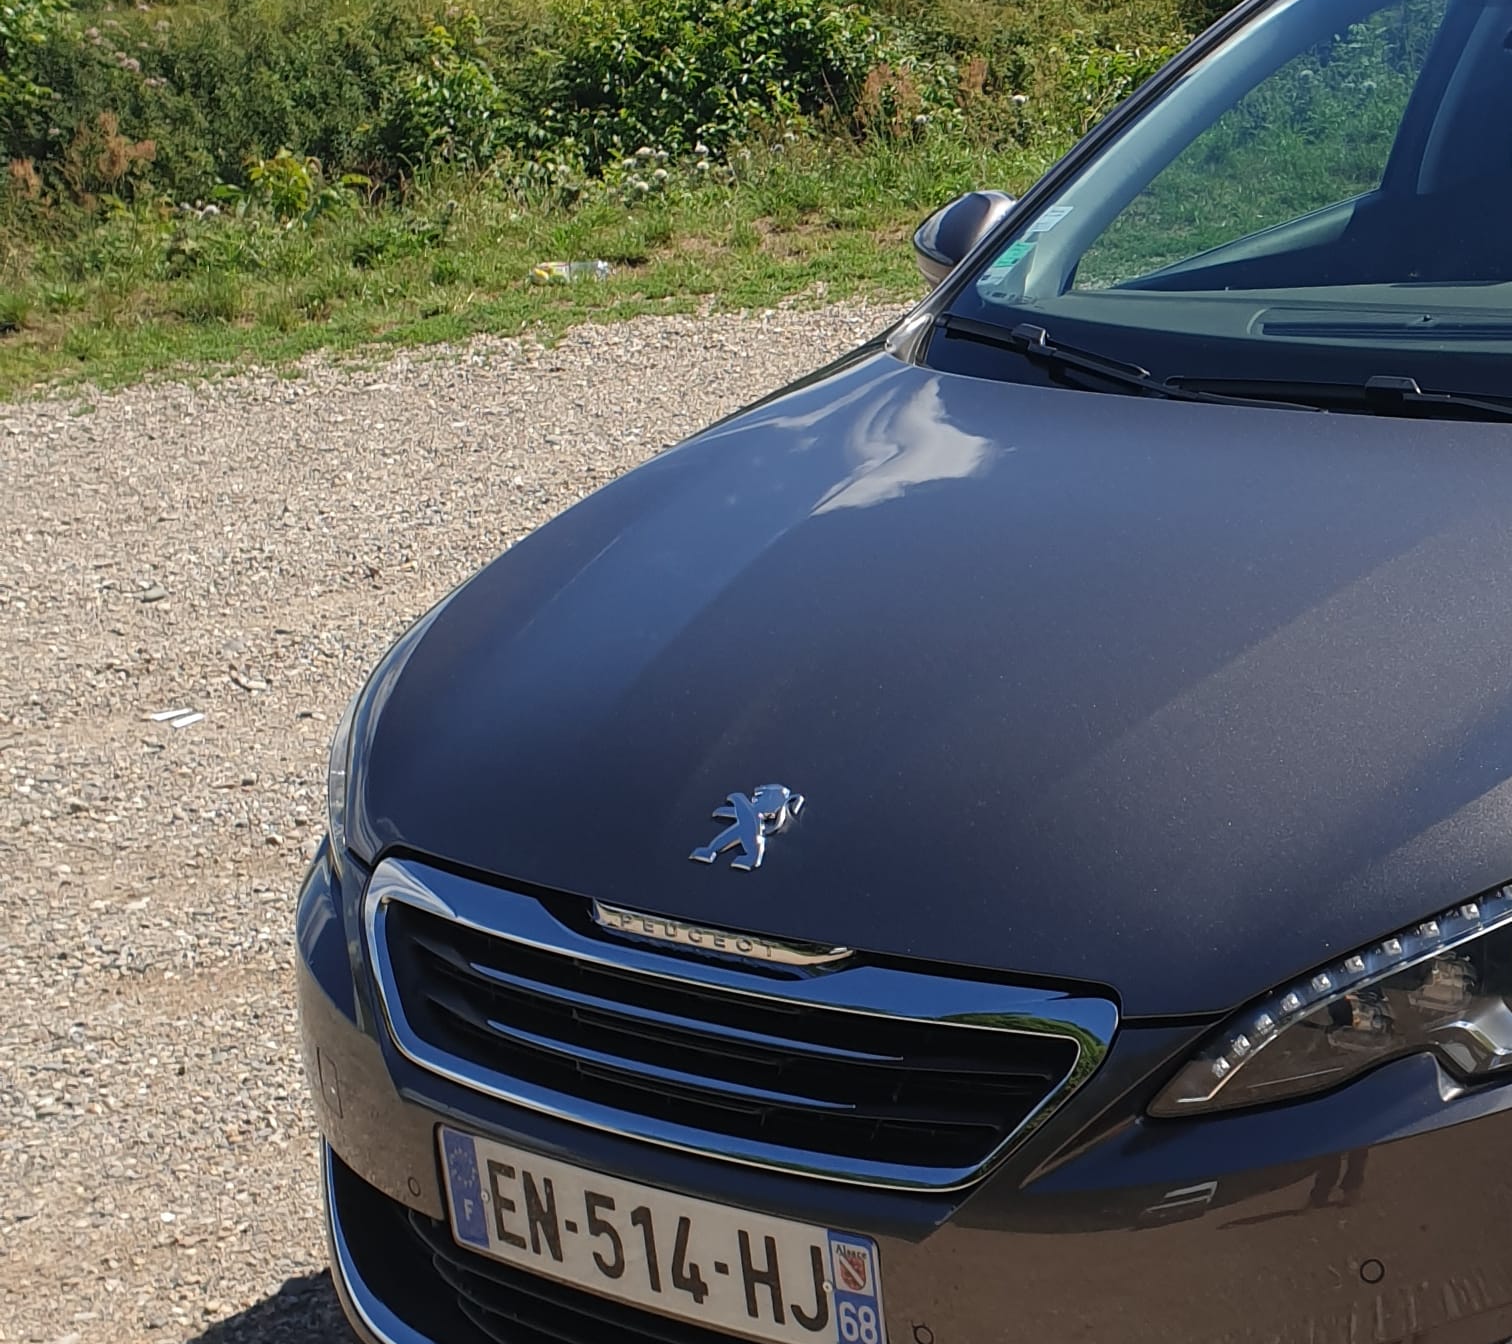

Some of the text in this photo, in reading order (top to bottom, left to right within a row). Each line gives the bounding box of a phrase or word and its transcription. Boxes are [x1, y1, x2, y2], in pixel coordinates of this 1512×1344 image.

[619, 914, 775, 958] PEUGEOT
[462, 1198, 474, 1222] F
[487, 1159, 831, 1332] EN-514-HJ
